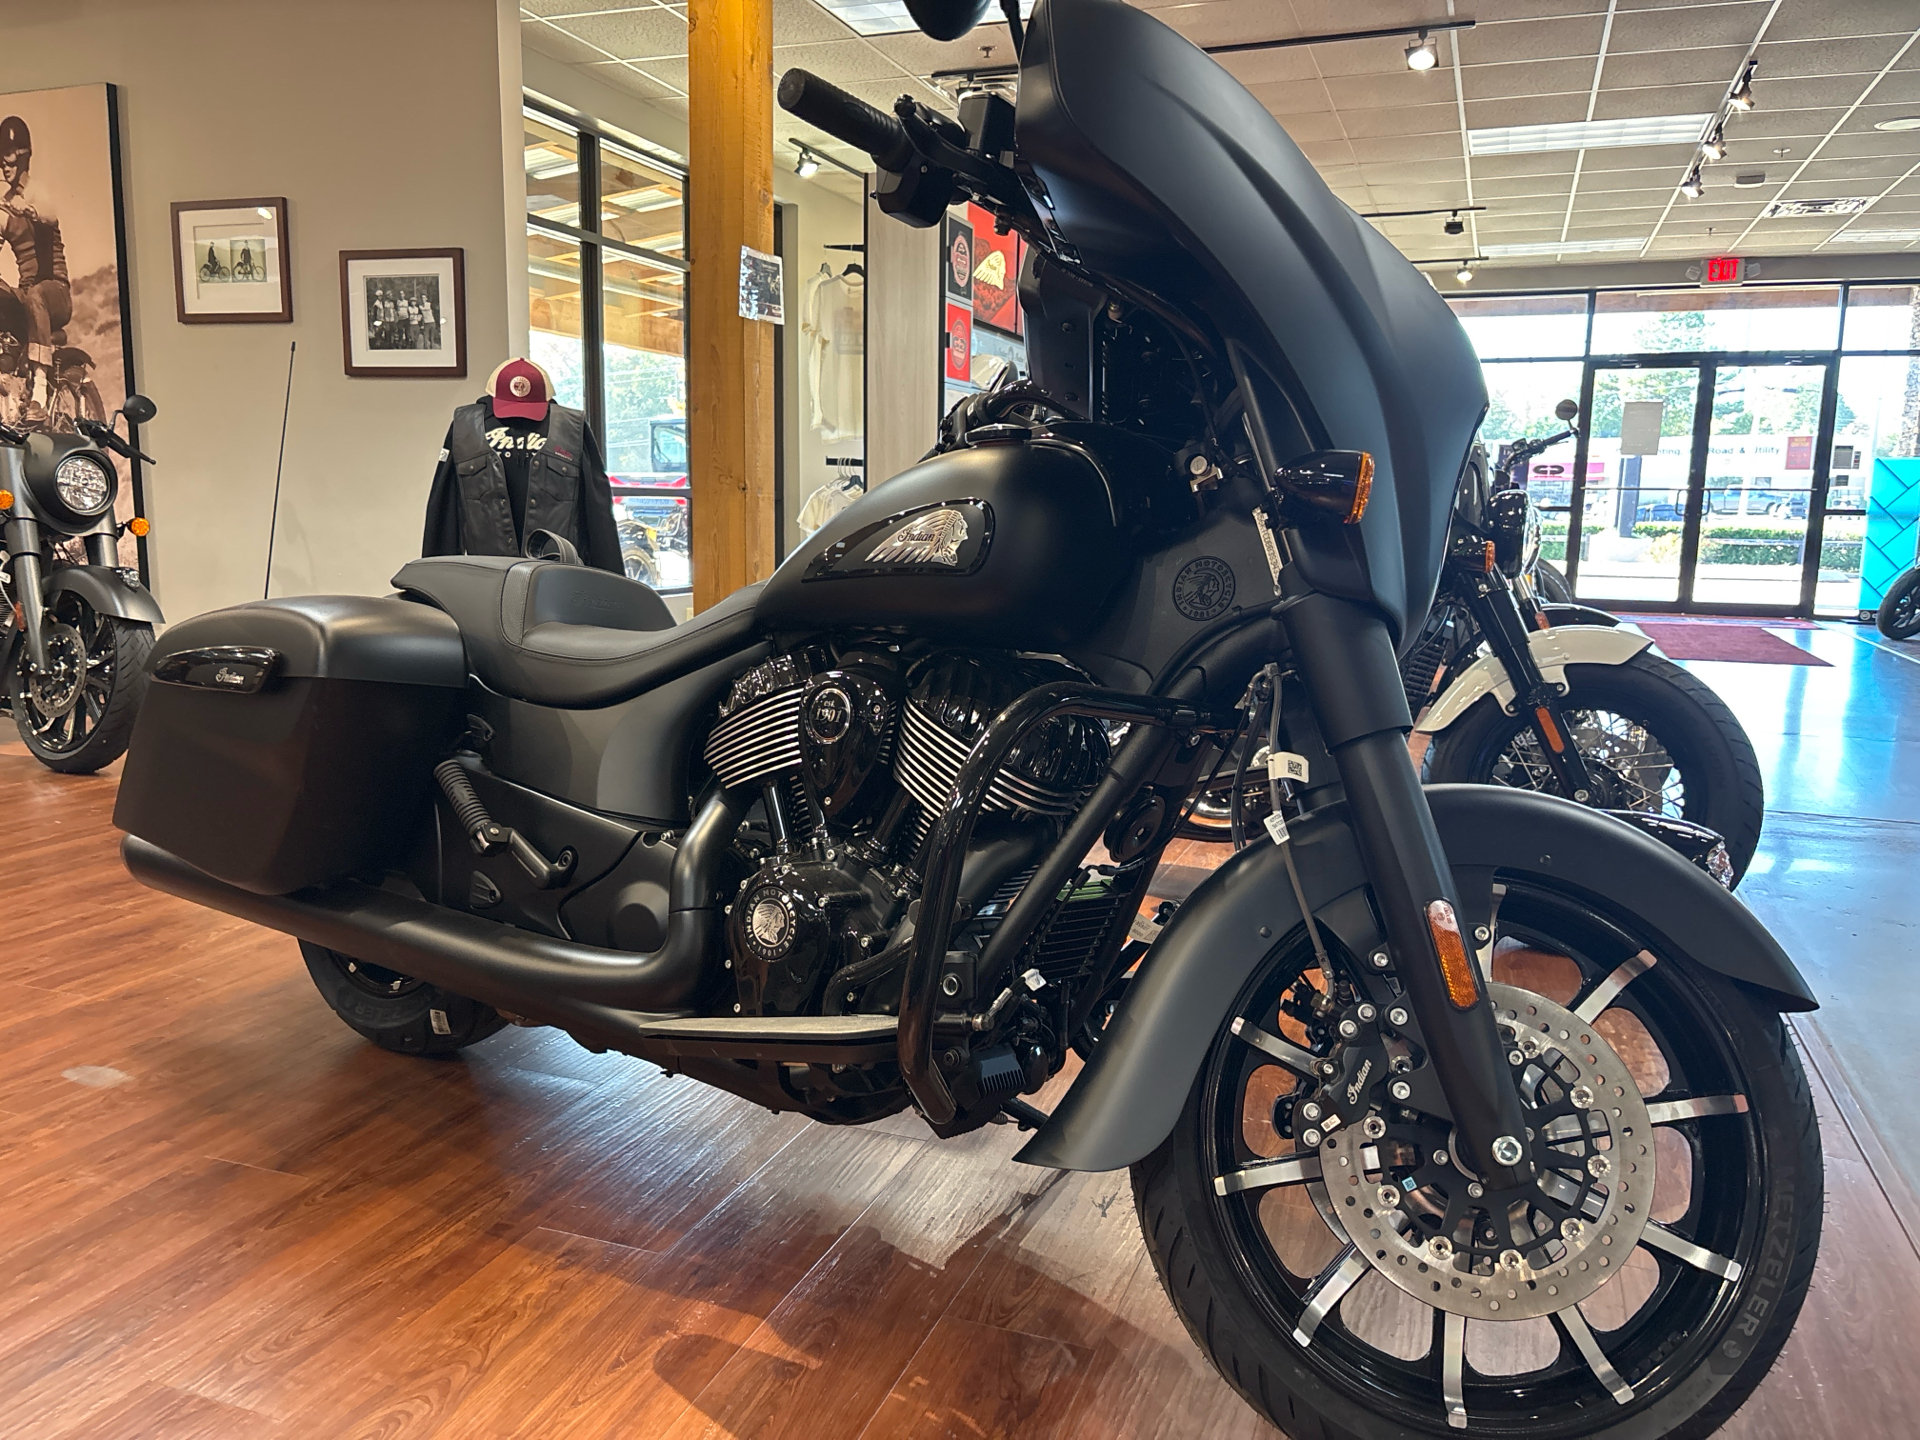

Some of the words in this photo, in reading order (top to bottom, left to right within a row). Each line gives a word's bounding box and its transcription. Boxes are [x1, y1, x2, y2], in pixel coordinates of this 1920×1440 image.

[1708, 259, 1739, 281] EXIT
[898, 528, 935, 543] Indian
[1175, 567, 1192, 606] INDIAN
[1195, 560, 1232, 609] MOTORCYCLE
[1189, 609, 1210, 618] 1901
[815, 708, 842, 722] 1901
[746, 895, 760, 939] INDIAN
[763, 889, 796, 949] MOTORCYCLE
[757, 945, 776, 957] 1901
[1347, 1059, 1372, 1105] Indian
[1736, 1166, 1795, 1338] METZELER
